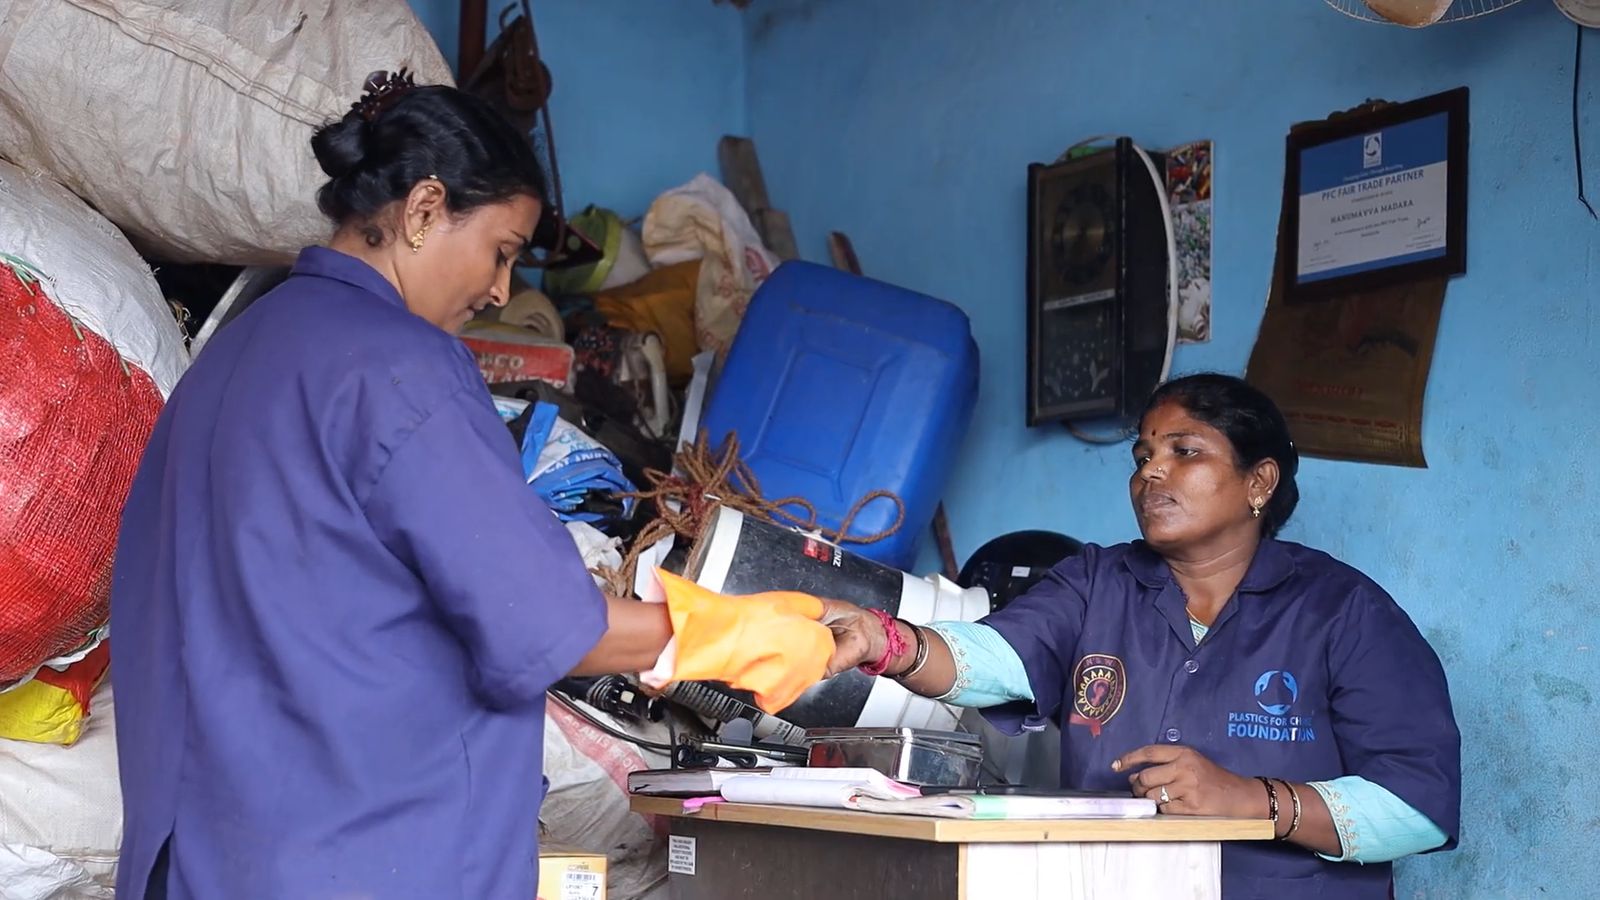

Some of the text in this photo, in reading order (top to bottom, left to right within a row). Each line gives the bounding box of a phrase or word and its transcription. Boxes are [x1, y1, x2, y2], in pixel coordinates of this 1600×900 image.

[1321, 189, 1337, 201] PFC
[1337, 184, 1356, 197] FAIR
[1358, 178, 1382, 192] TRADE
[1385, 169, 1424, 185] PARTNER
[1228, 712, 1269, 724] PLASTICS
[1270, 716, 1287, 726] FOR
[1227, 723, 1316, 742] FOUNDATION
[592, 885, 599, 896] 7
